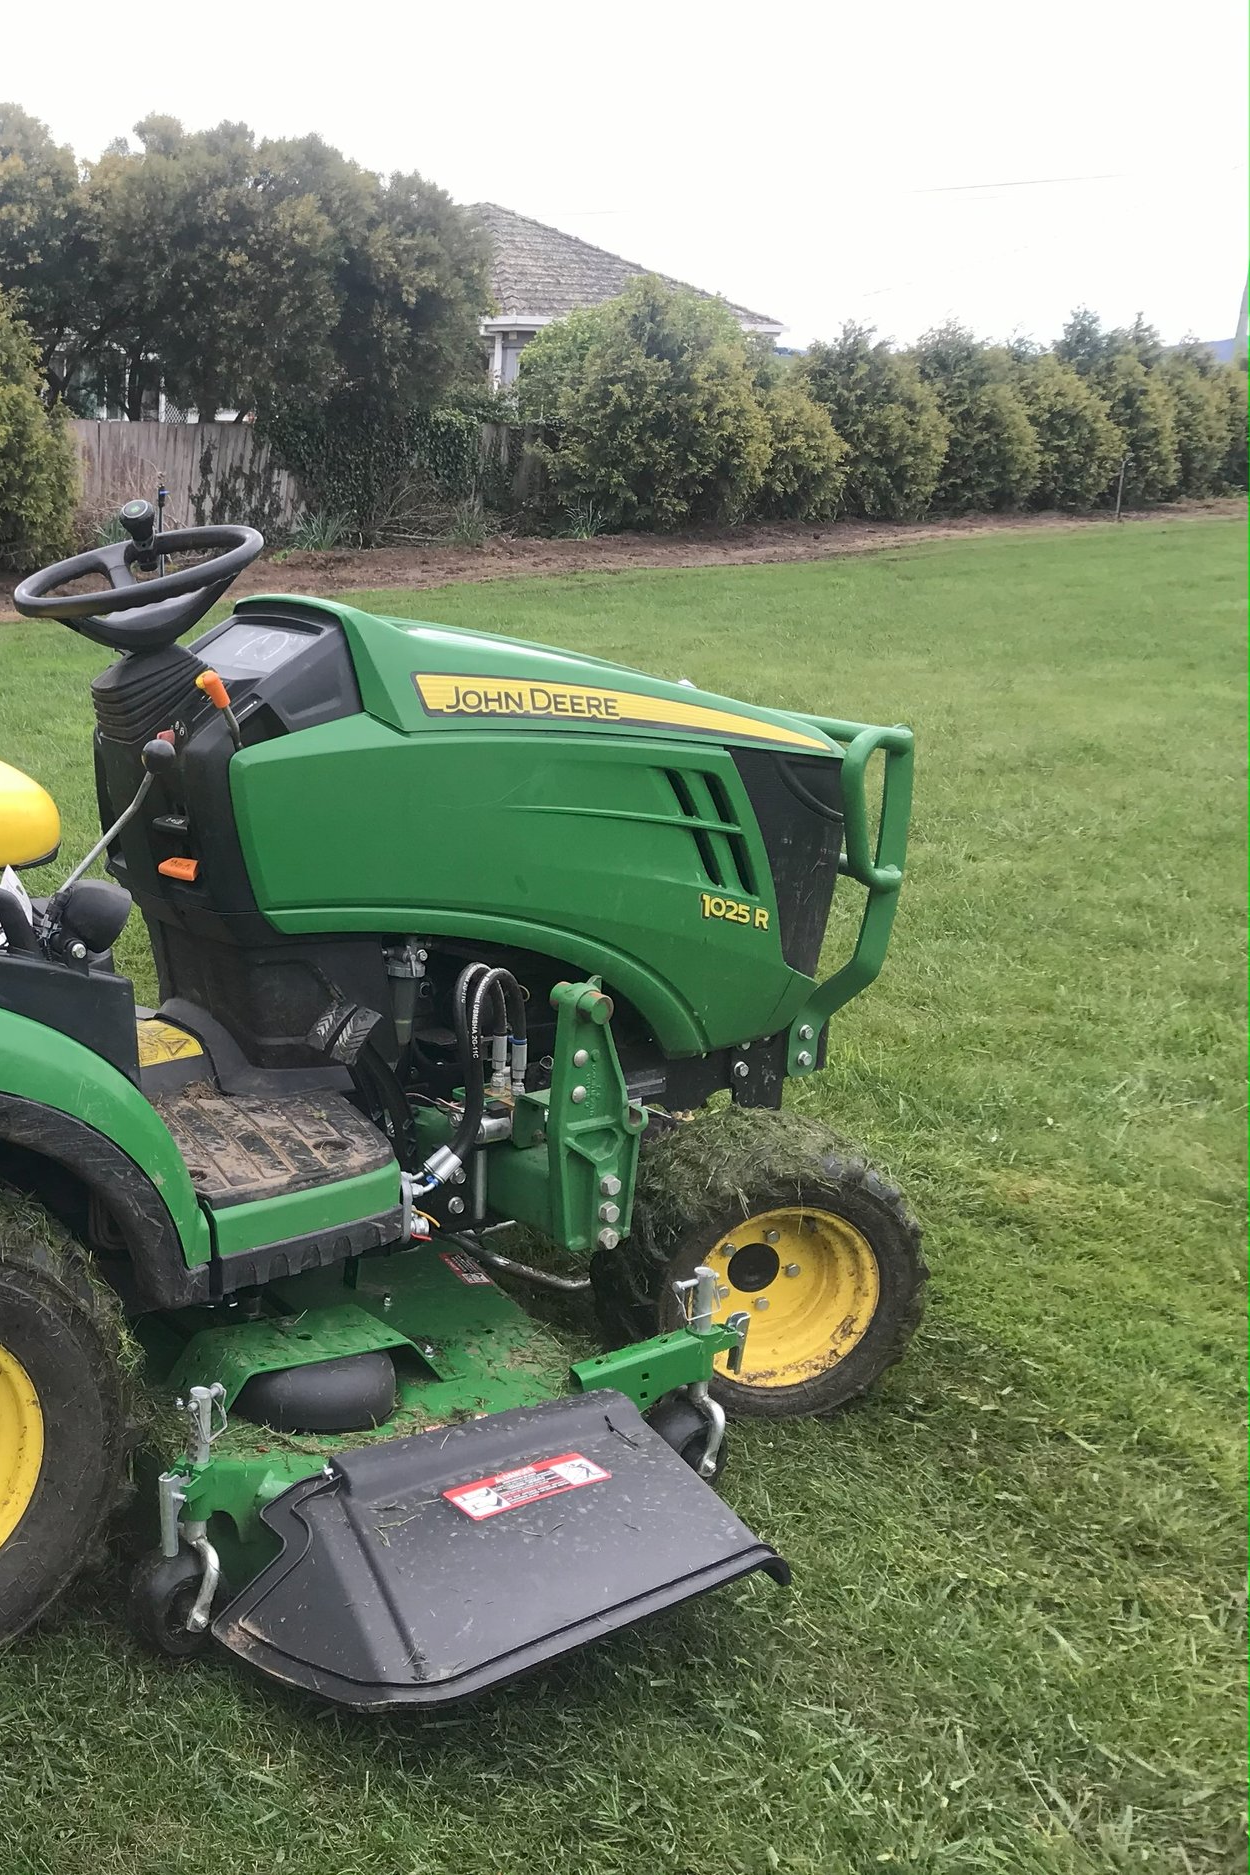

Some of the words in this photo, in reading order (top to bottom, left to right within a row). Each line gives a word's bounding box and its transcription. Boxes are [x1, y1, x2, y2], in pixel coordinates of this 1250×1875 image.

[446, 686, 524, 711] JOHN
[529, 688, 620, 717] DEERE
[702, 893, 751, 925] 1025
[753, 907, 770, 931] R
[471, 1035, 479, 1059] 2G-11C
